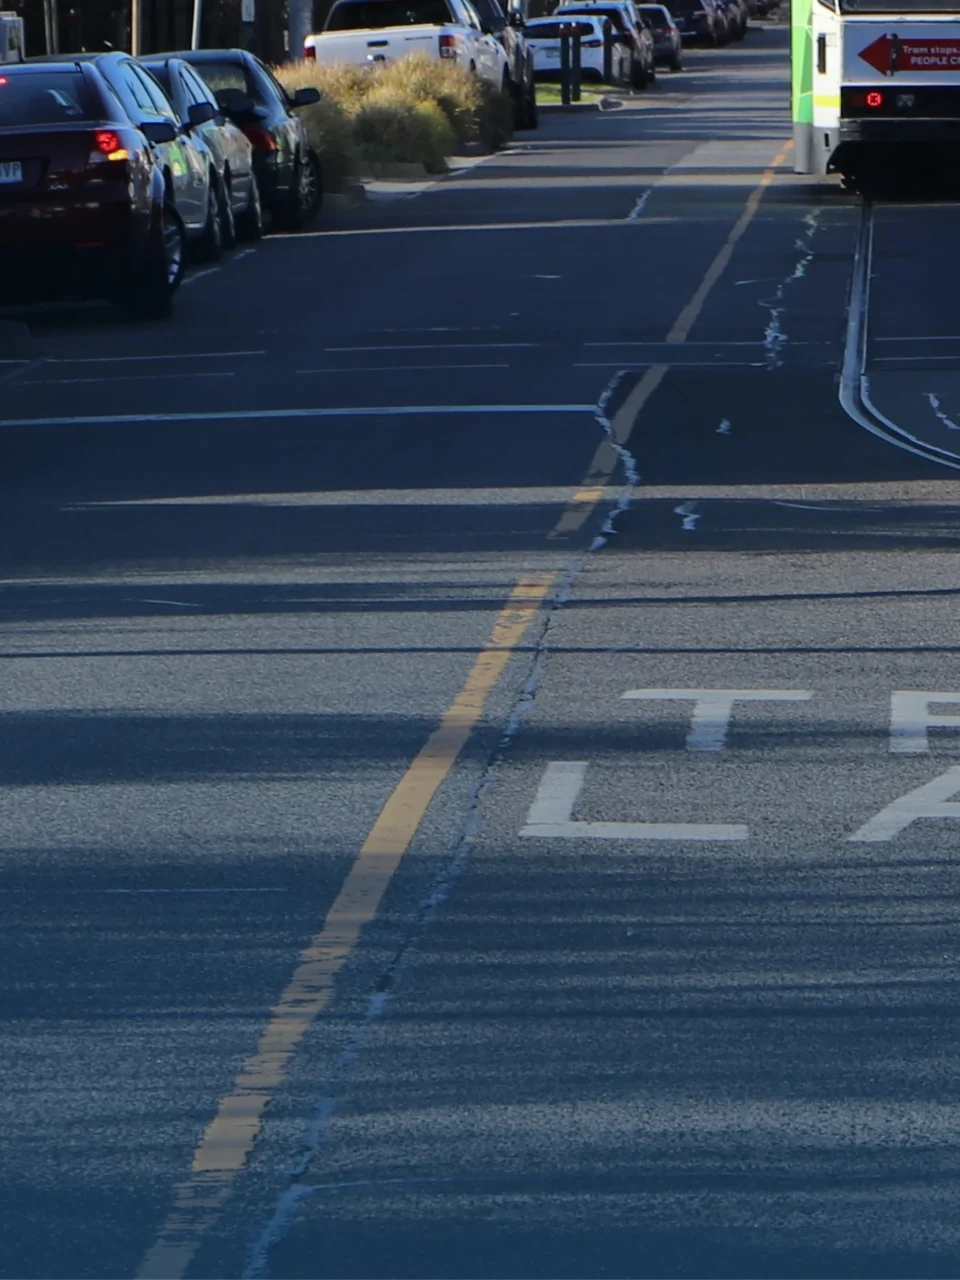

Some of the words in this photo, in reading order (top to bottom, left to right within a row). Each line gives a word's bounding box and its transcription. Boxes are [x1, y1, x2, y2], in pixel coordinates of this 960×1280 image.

[902, 45, 929, 54] Tram
[930, 45, 960, 56] stops.
[910, 56, 949, 66] PEOPLE
